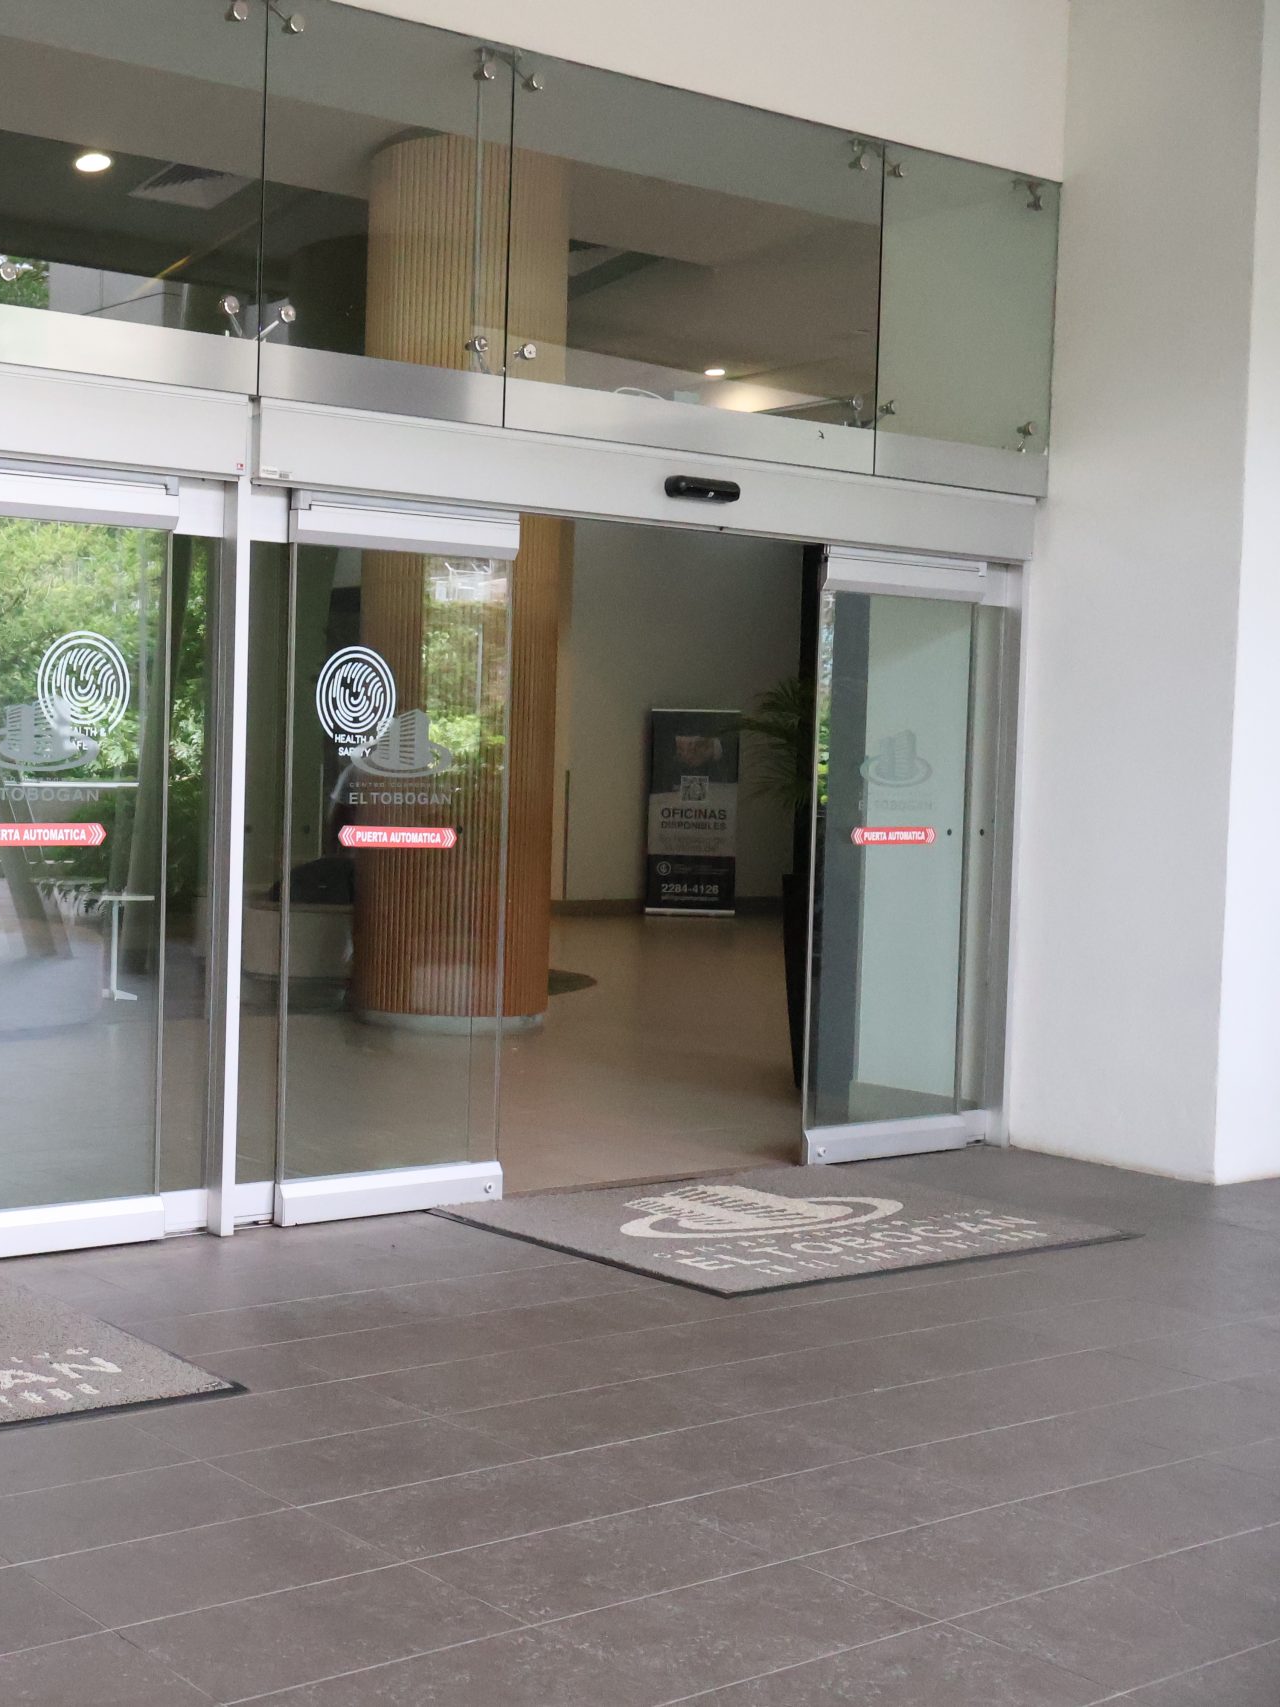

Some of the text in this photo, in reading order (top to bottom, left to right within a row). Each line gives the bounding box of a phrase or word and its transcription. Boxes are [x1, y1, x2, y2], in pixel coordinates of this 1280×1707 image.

[334, 733, 367, 744] HEALTH
[338, 746, 371, 757] SAFY
[349, 792, 452, 805] EL TOBOGAN
[661, 807, 728, 820] OFICINAS
[661, 821, 727, 831] DISPONIBLES
[23, 829, 86, 841] AUTOMATICA
[356, 831, 441, 843] PUERTA AUTOMATICA
[863, 831, 926, 841] PUERTA AUTOMATICA
[661, 883, 719, 894] 2284-4126
[747, 1215, 1038, 1258] TOBOGAN
